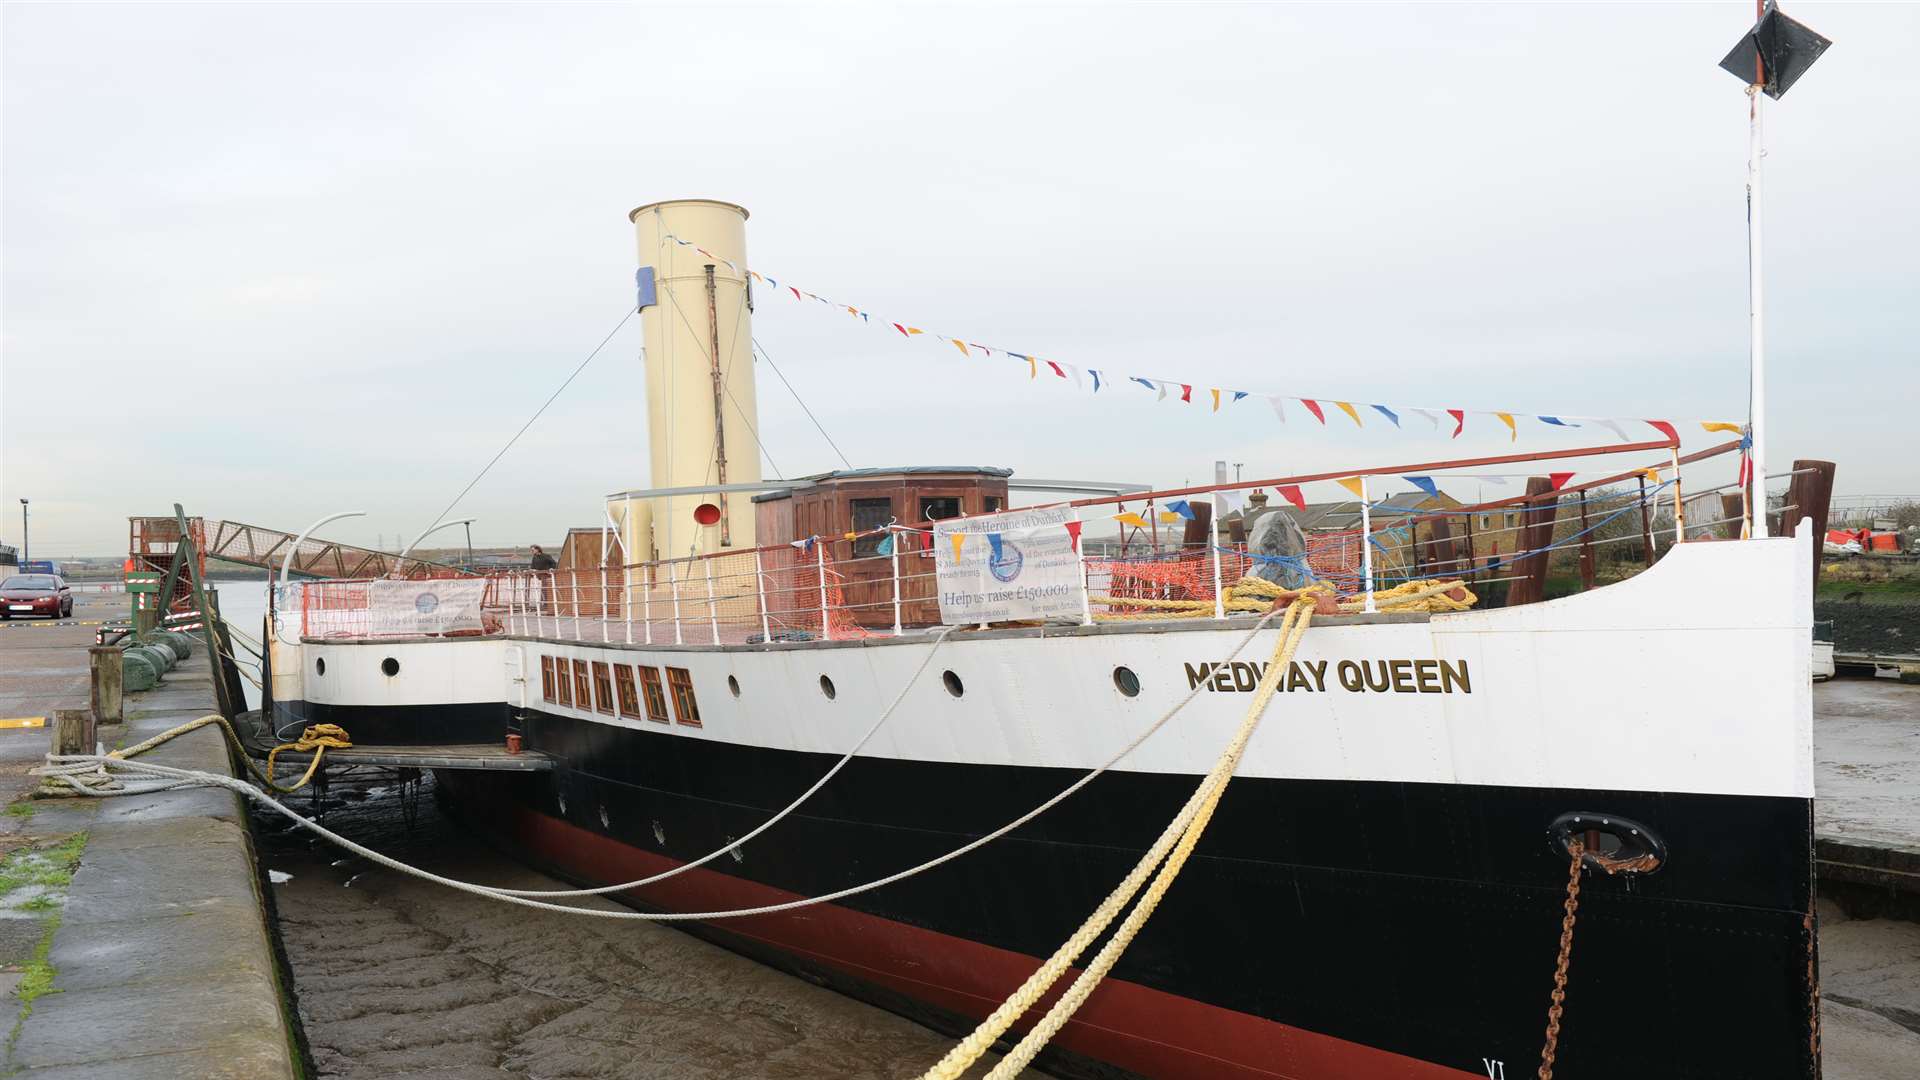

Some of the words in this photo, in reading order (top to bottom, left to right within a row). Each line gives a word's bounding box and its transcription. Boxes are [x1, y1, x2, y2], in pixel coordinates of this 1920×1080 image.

[982, 519, 1020, 534] Heroine
[1022, 515, 1031, 527] of
[944, 591, 973, 608] Help
[974, 592, 984, 604] us
[988, 587, 1014, 602] raise
[1337, 659, 1472, 694] QUEEN
